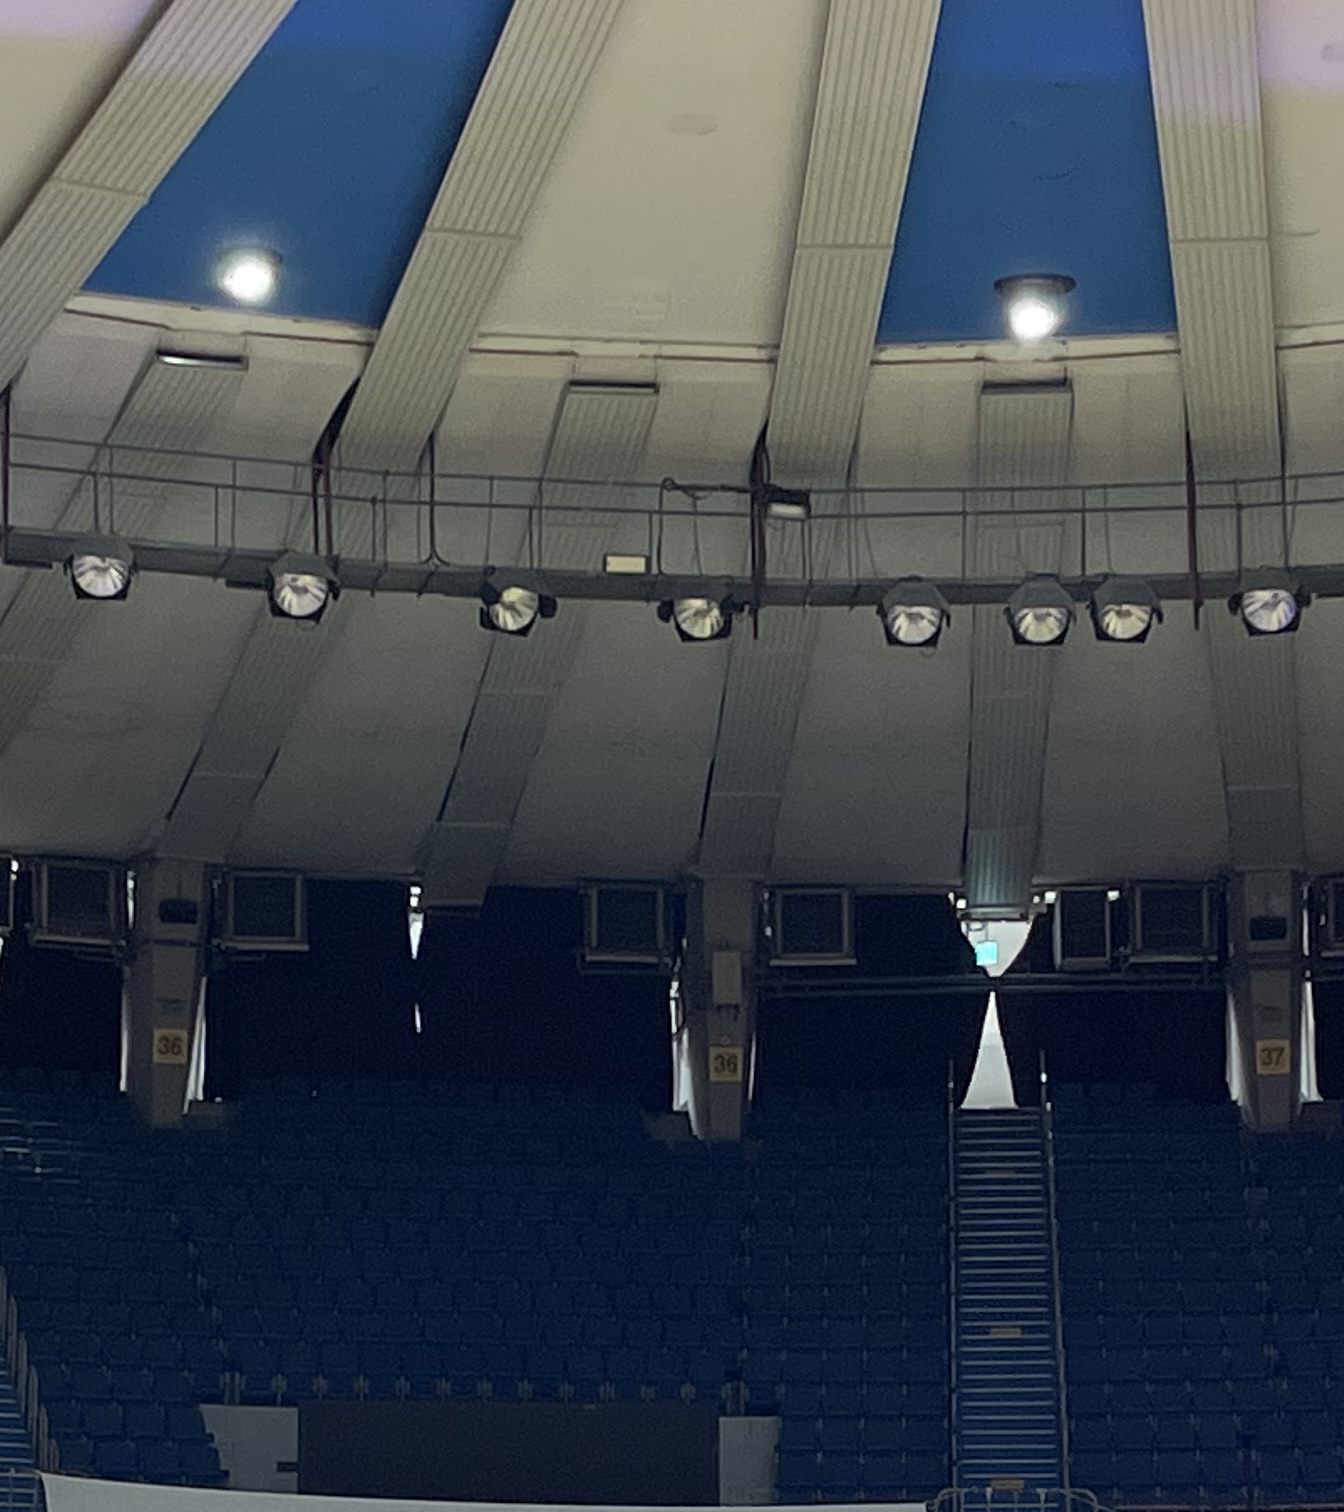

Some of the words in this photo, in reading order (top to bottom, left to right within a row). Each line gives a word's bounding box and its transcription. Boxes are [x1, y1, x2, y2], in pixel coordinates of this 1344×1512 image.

[157, 1033, 183, 1056] 36
[713, 1053, 739, 1075] 36
[1259, 1046, 1285, 1067] 37
